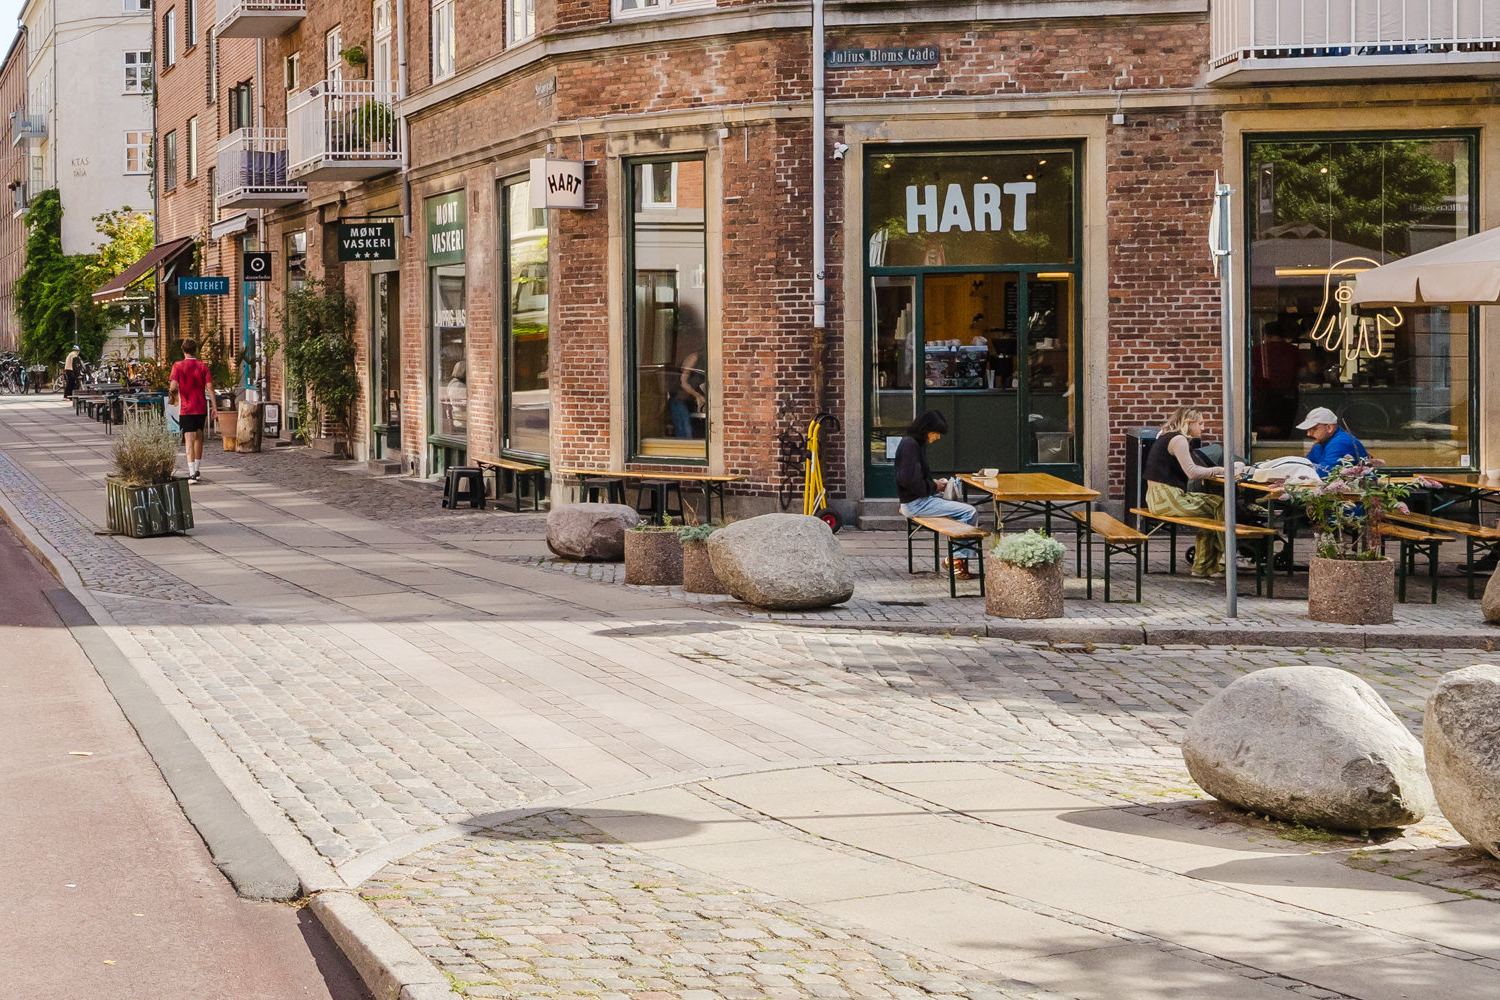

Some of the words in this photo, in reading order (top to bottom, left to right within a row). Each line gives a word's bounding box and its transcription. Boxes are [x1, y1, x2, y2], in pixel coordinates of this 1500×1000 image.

[830, 50, 865, 64] Julius
[870, 49, 903, 62] Bloms
[908, 47, 935, 61] Gade
[547, 172, 582, 195] HART
[435, 201, 458, 226] MØNT
[906, 182, 1037, 233] HART
[343, 238, 391, 249] VASKERI
[350, 227, 382, 238] MØNT
[431, 229, 464, 254] VASKERI
